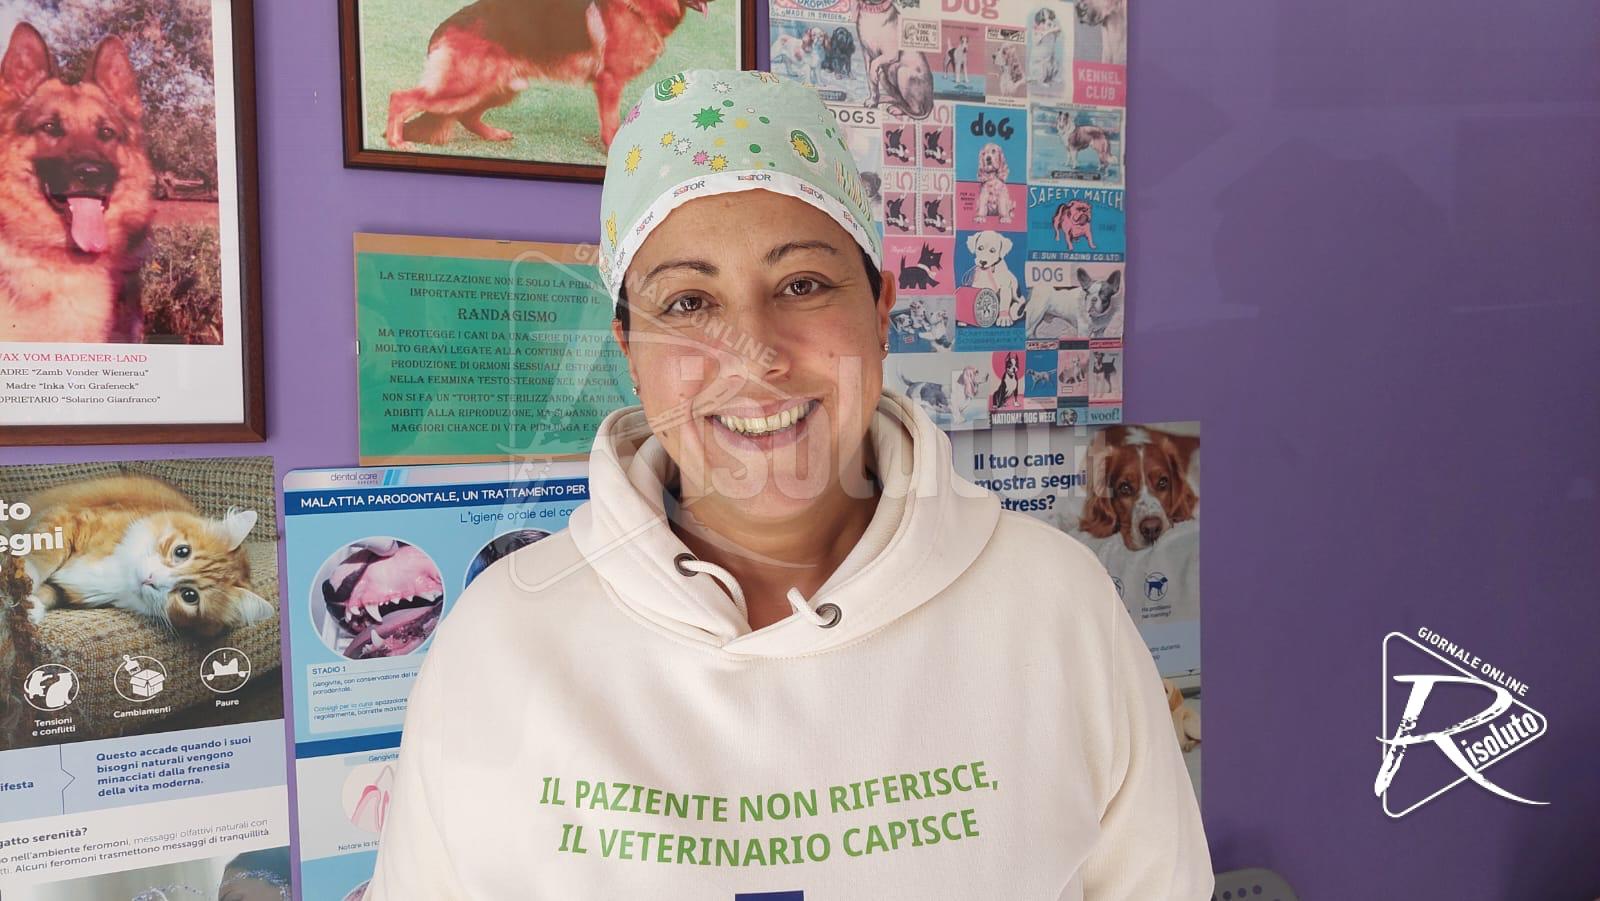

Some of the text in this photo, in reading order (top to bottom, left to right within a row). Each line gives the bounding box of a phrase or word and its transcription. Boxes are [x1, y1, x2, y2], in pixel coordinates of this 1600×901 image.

[1077, 68, 1120, 85] KENNEL
[1084, 86, 1116, 100] CLUB
[1029, 187, 1124, 211] SAFETY MATCH
[1042, 251, 1091, 261] SUN TRADING
[379, 271, 566, 288] LA STERILIZZAZIONE NON SOLO LA
[1031, 267, 1063, 282] DOG
[410, 287, 478, 299] IMPORTANTE
[480, 289, 549, 302] PREVENZIONE
[551, 294, 588, 304] CONTRO
[457, 307, 557, 322] RANDAGISMO
[378, 328, 396, 338] MA
[399, 329, 454, 339] PROTEGGE
[464, 330, 489, 341] CANI
[491, 332, 505, 341] DA
[509, 332, 529, 342] UNA
[23, 353, 52, 362] VOM
[375, 343, 573, 358] MOLTO GRAVI LEGATE ALLA CONTINUA
[391, 359, 457, 370] PRODUZIONE
[459, 361, 470, 370] DI
[472, 361, 511, 371] ORMONI
[65, 369, 100, 377] Vonder
[389, 375, 424, 384] NELLA
[427, 375, 475, 385] FEMMINA
[477, 376, 554, 386] TESTOSTERONE
[6, 382, 37, 390] Madre
[67, 382, 86, 391] Von
[382, 393, 404, 402] NON
[406, 393, 416, 402] SI
[417, 393, 433, 402] FA
[436, 393, 450, 402] UN
[497, 394, 574, 403] STERILIZZANDO
[384, 408, 424, 418] ADIBITI
[427, 408, 455, 418] ALLA
[458, 408, 534, 419] RIPRODUZIONE,
[991, 411, 1056, 424] NATIONAL DOG WEEK
[391, 423, 445, 433] MAGGIORI
[447, 423, 489, 433] CHANCE
[491, 423, 501, 433] DI
[504, 423, 527, 433] VITA
[973, 452, 1065, 470] Il tuo cane
[330, 471, 378, 481] dental care
[1041, 470, 1087, 489] segni
[300, 485, 586, 508] MALATTIA PARODONTALE, UN TRATTAMENTO PER
[460, 507, 556, 525] L'igiene orale del
[312, 666, 341, 675] STADIO
[215, 698, 240, 708] Paure
[113, 705, 172, 719] Cambiamenti
[33, 716, 73, 727] Tensioni
[39, 724, 76, 736] conflitti
[96, 749, 138, 763] Questo
[139, 745, 178, 758] accade
[180, 741, 221, 755] quando
[229, 736, 252, 747] suoi
[96, 750, 234, 776] bisogni naturali vengono
[97, 762, 231, 786] minacciati dalla frenesia
[98, 777, 204, 798] della vita moderna.
[539, 760, 998, 823] IL PAZIENTE NON RIFERISCE,
[11, 845, 81, 863] nell'ambiente
[133, 833, 178, 849] messaggi
[215, 821, 249, 834] naturali
[250, 819, 268, 828] con
[32, 827, 88, 843] serenità?
[558, 808, 980, 868] IL VETERINARIO CAPISCE
[15, 827, 269, 873] Alcuni feromoni trasmettono messaggi di tranquillità
